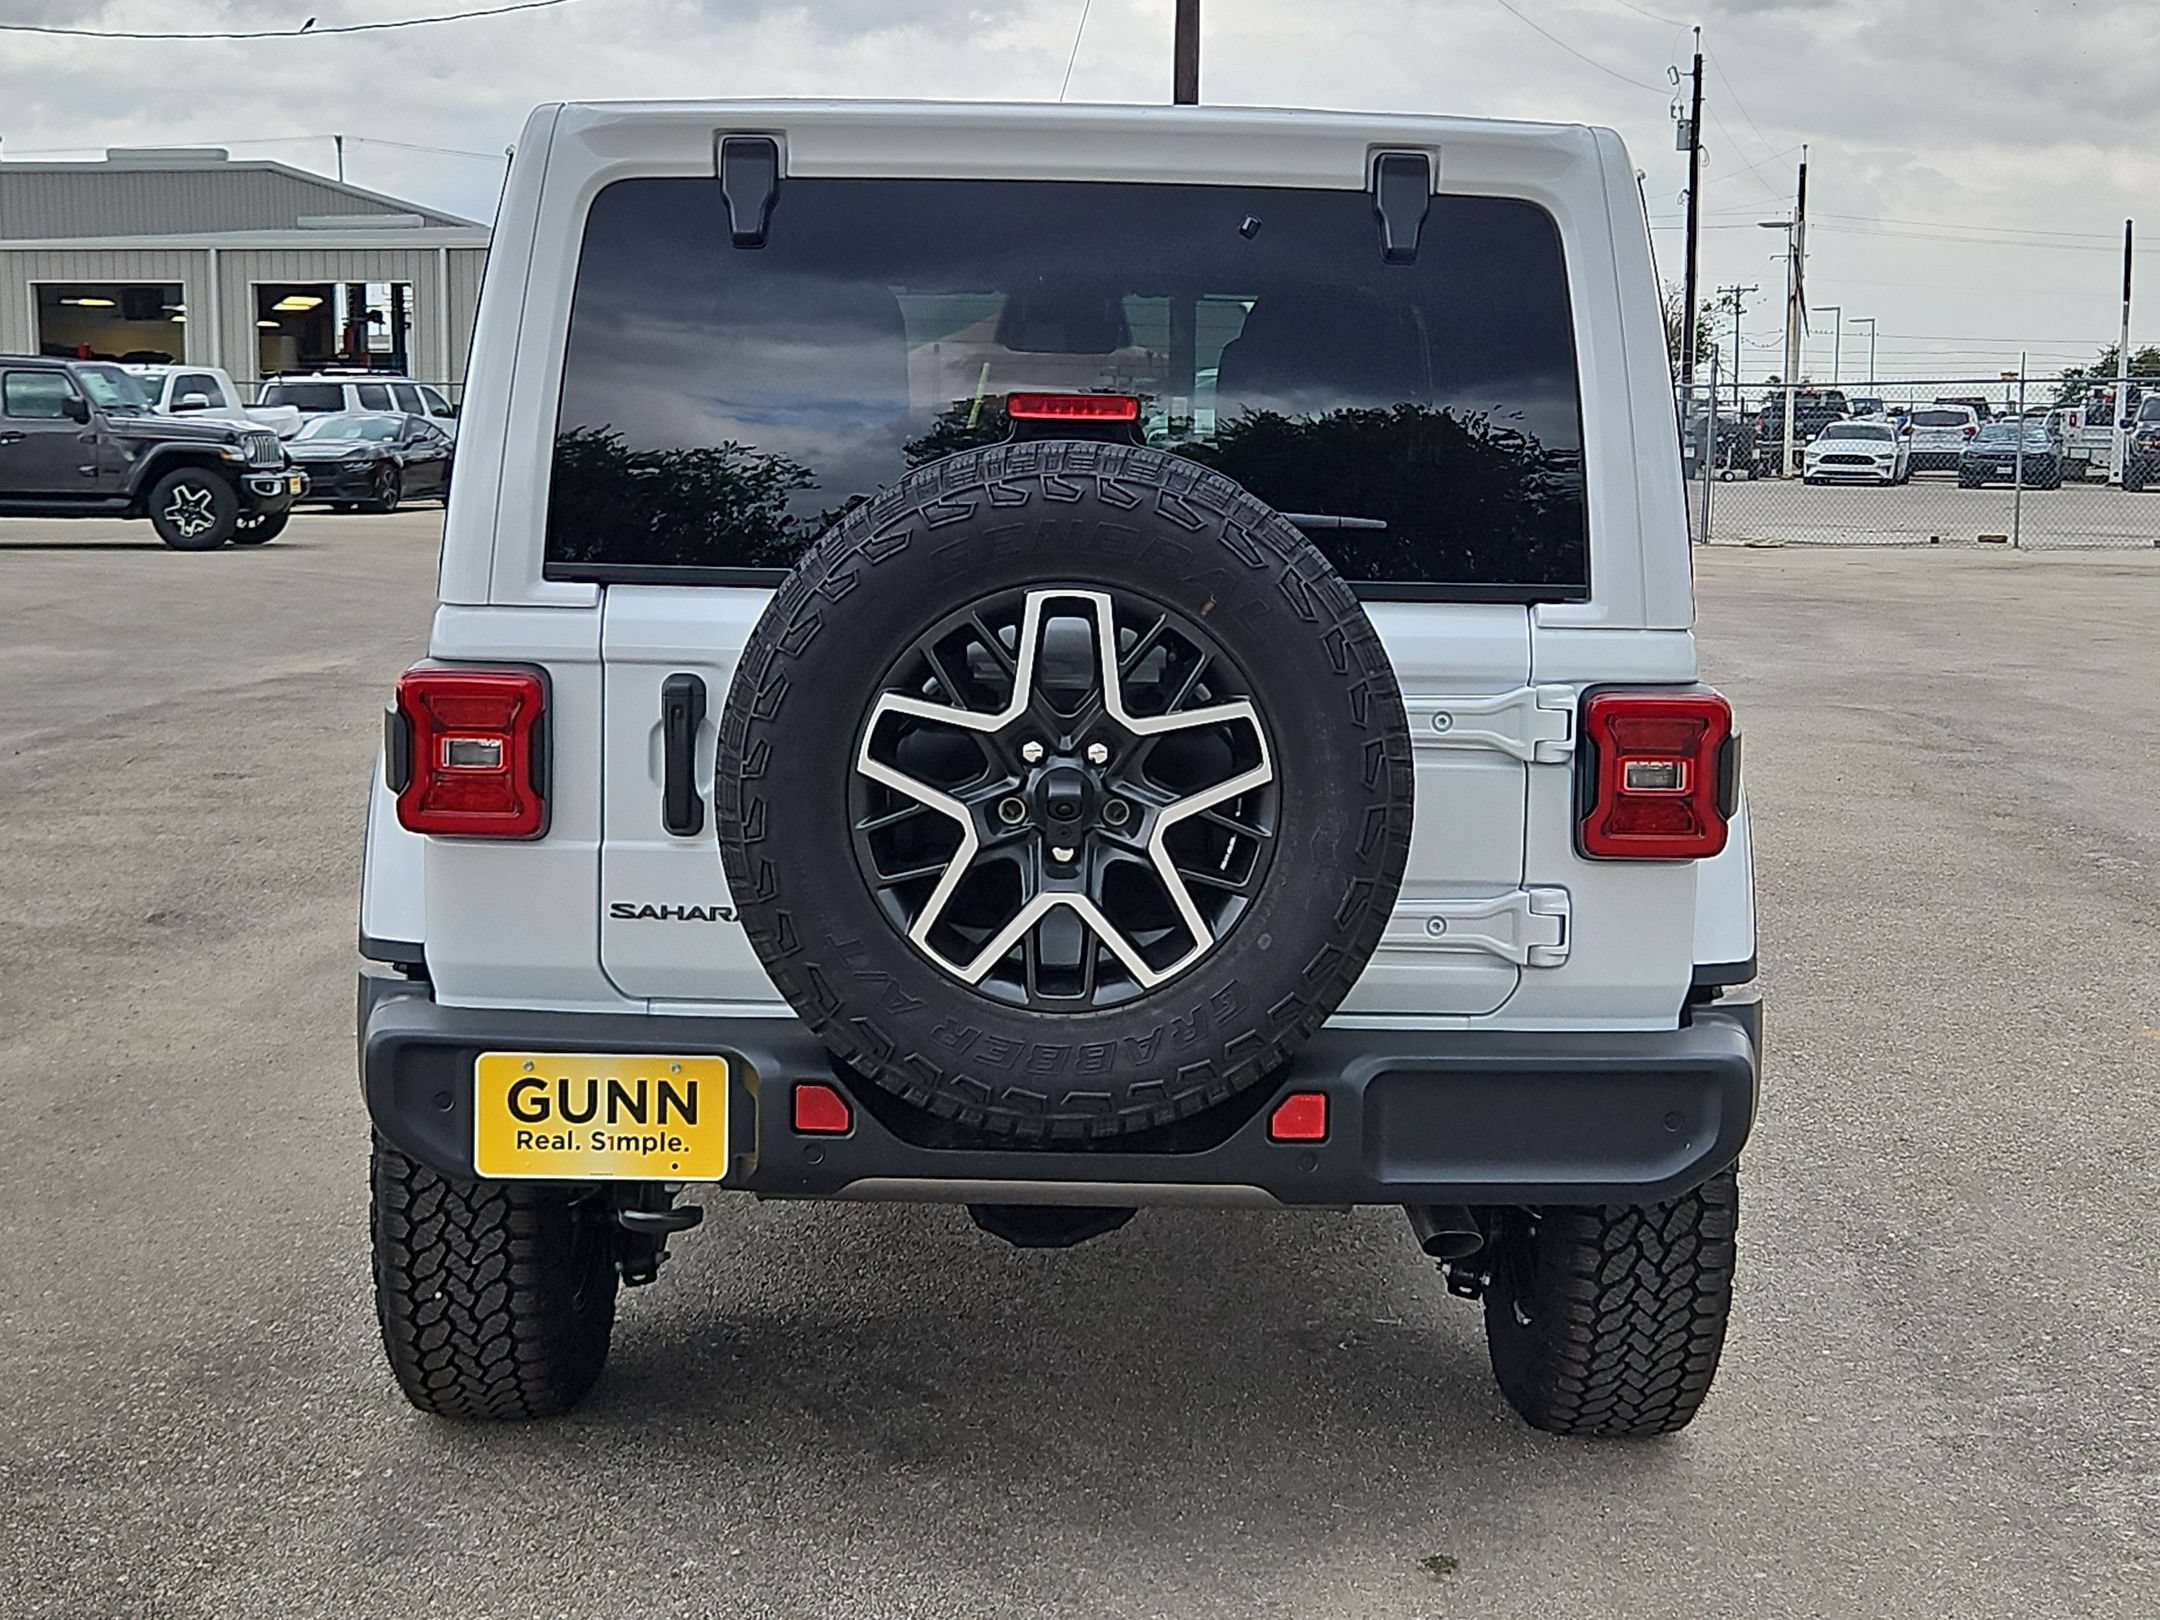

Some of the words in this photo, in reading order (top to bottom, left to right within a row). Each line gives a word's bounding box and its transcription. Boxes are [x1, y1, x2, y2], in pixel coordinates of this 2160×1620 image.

[928, 519, 1271, 633] GENERAL
[610, 903, 739, 921] SAHAR
[930, 978, 1251, 1076] GRABBER
[507, 1077, 698, 1126] GUNN
[516, 1130, 581, 1151] Real.
